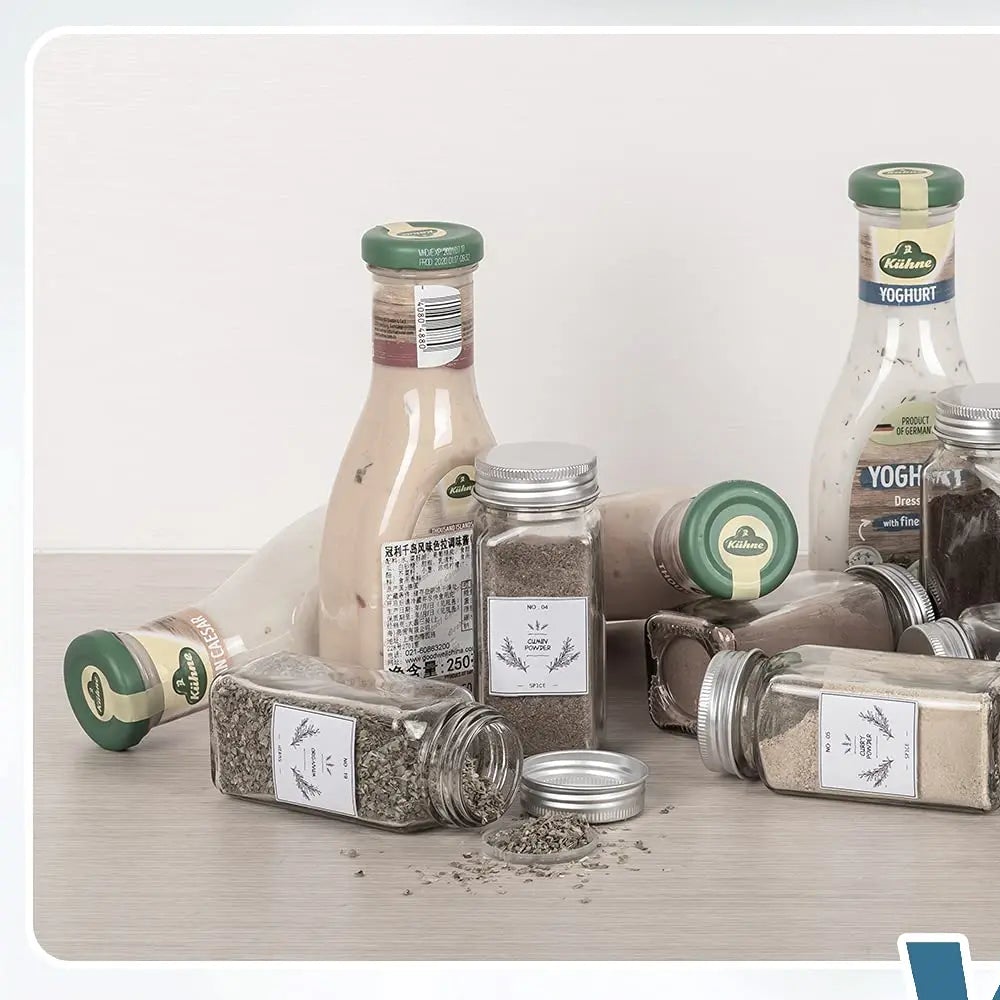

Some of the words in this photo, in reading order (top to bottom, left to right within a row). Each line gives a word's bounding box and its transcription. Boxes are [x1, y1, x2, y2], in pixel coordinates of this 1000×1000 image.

[884, 256, 933, 270] Kühne
[879, 285, 937, 303] YOGHURT
[901, 415, 930, 426] PRODUCT
[896, 426, 905, 436] OF
[905, 425, 932, 435] GERMAN
[449, 484, 473, 495] Kühn
[894, 495, 921, 507] Dress
[883, 519, 899, 528] with
[899, 515, 920, 527] fine
[727, 539, 765, 551] Kühne
[658, 563, 684, 593] THOU
[191, 615, 225, 666] CAESAR
[524, 644, 551, 652] POWDER
[183, 652, 200, 701] Kühne
